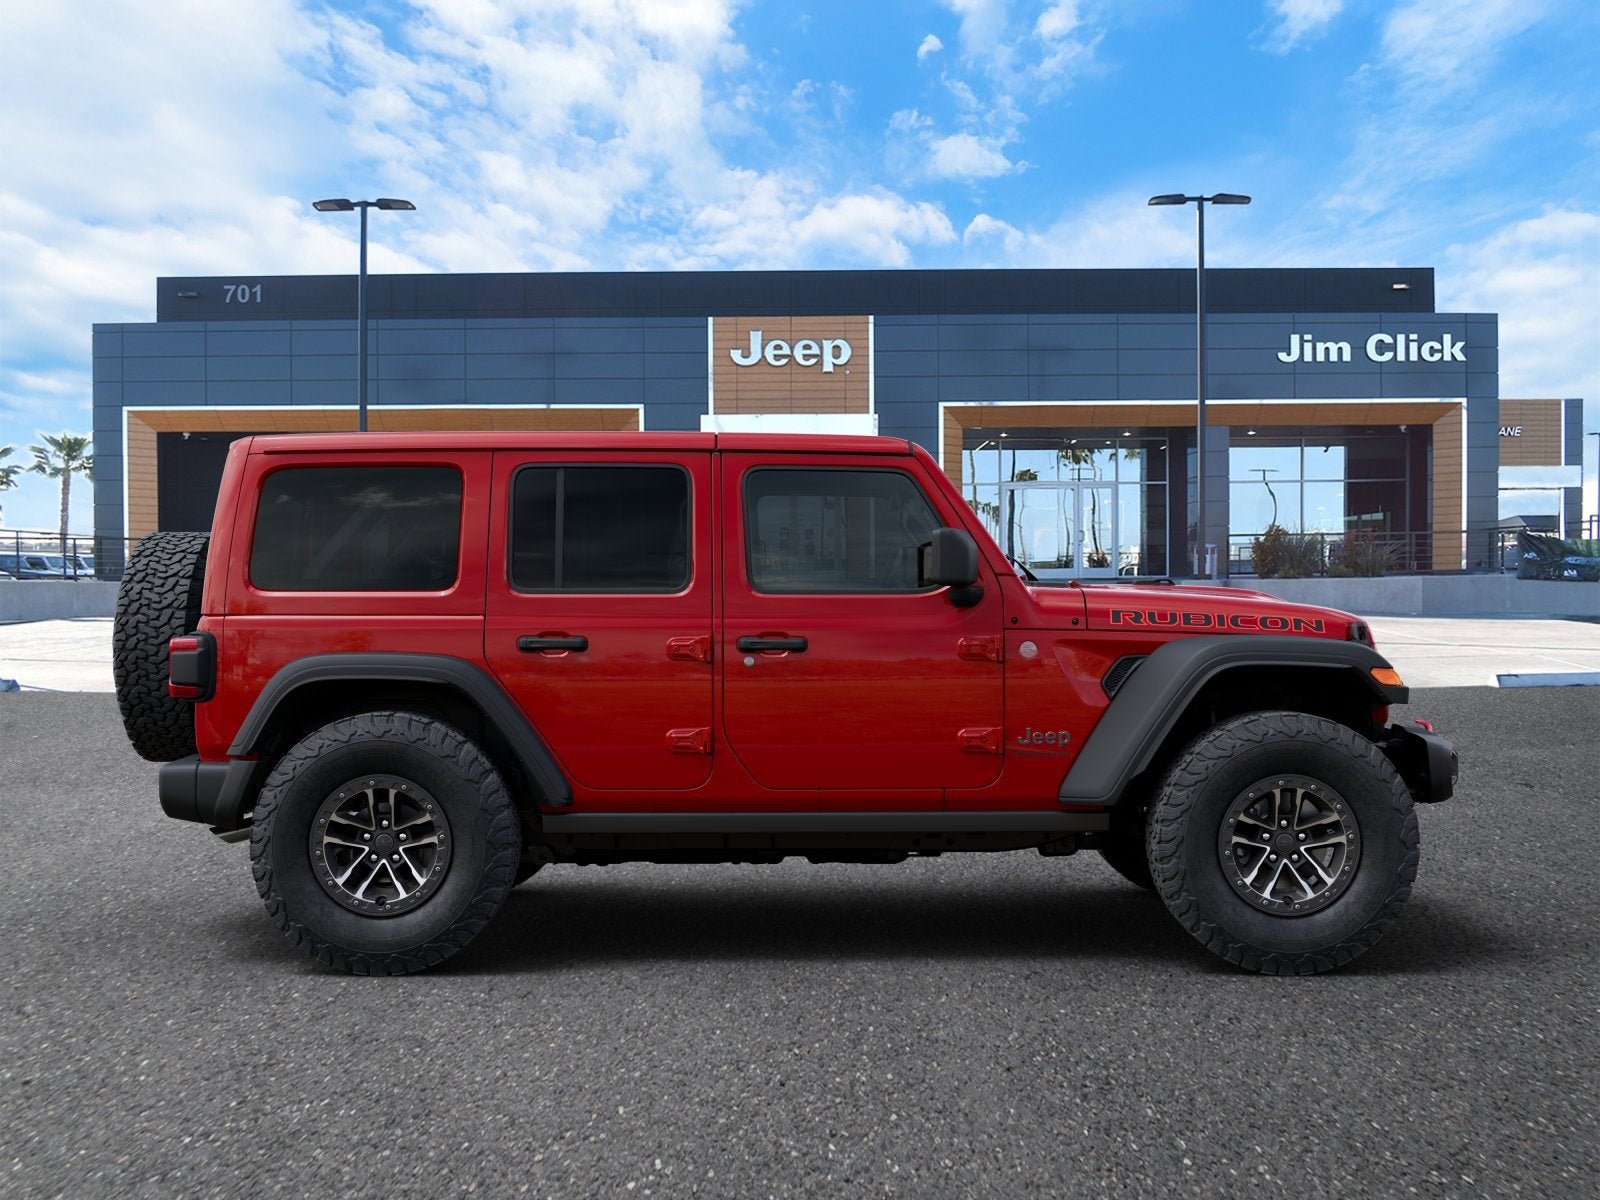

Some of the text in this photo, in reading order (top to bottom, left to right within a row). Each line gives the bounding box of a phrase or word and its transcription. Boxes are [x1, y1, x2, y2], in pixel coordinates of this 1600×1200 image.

[223, 284, 262, 304] 701
[729, 330, 852, 374] Jeep
[1277, 332, 1467, 363] Jim Click
[1109, 608, 1327, 634] RUBICON
[1016, 727, 1072, 748] Jeep
